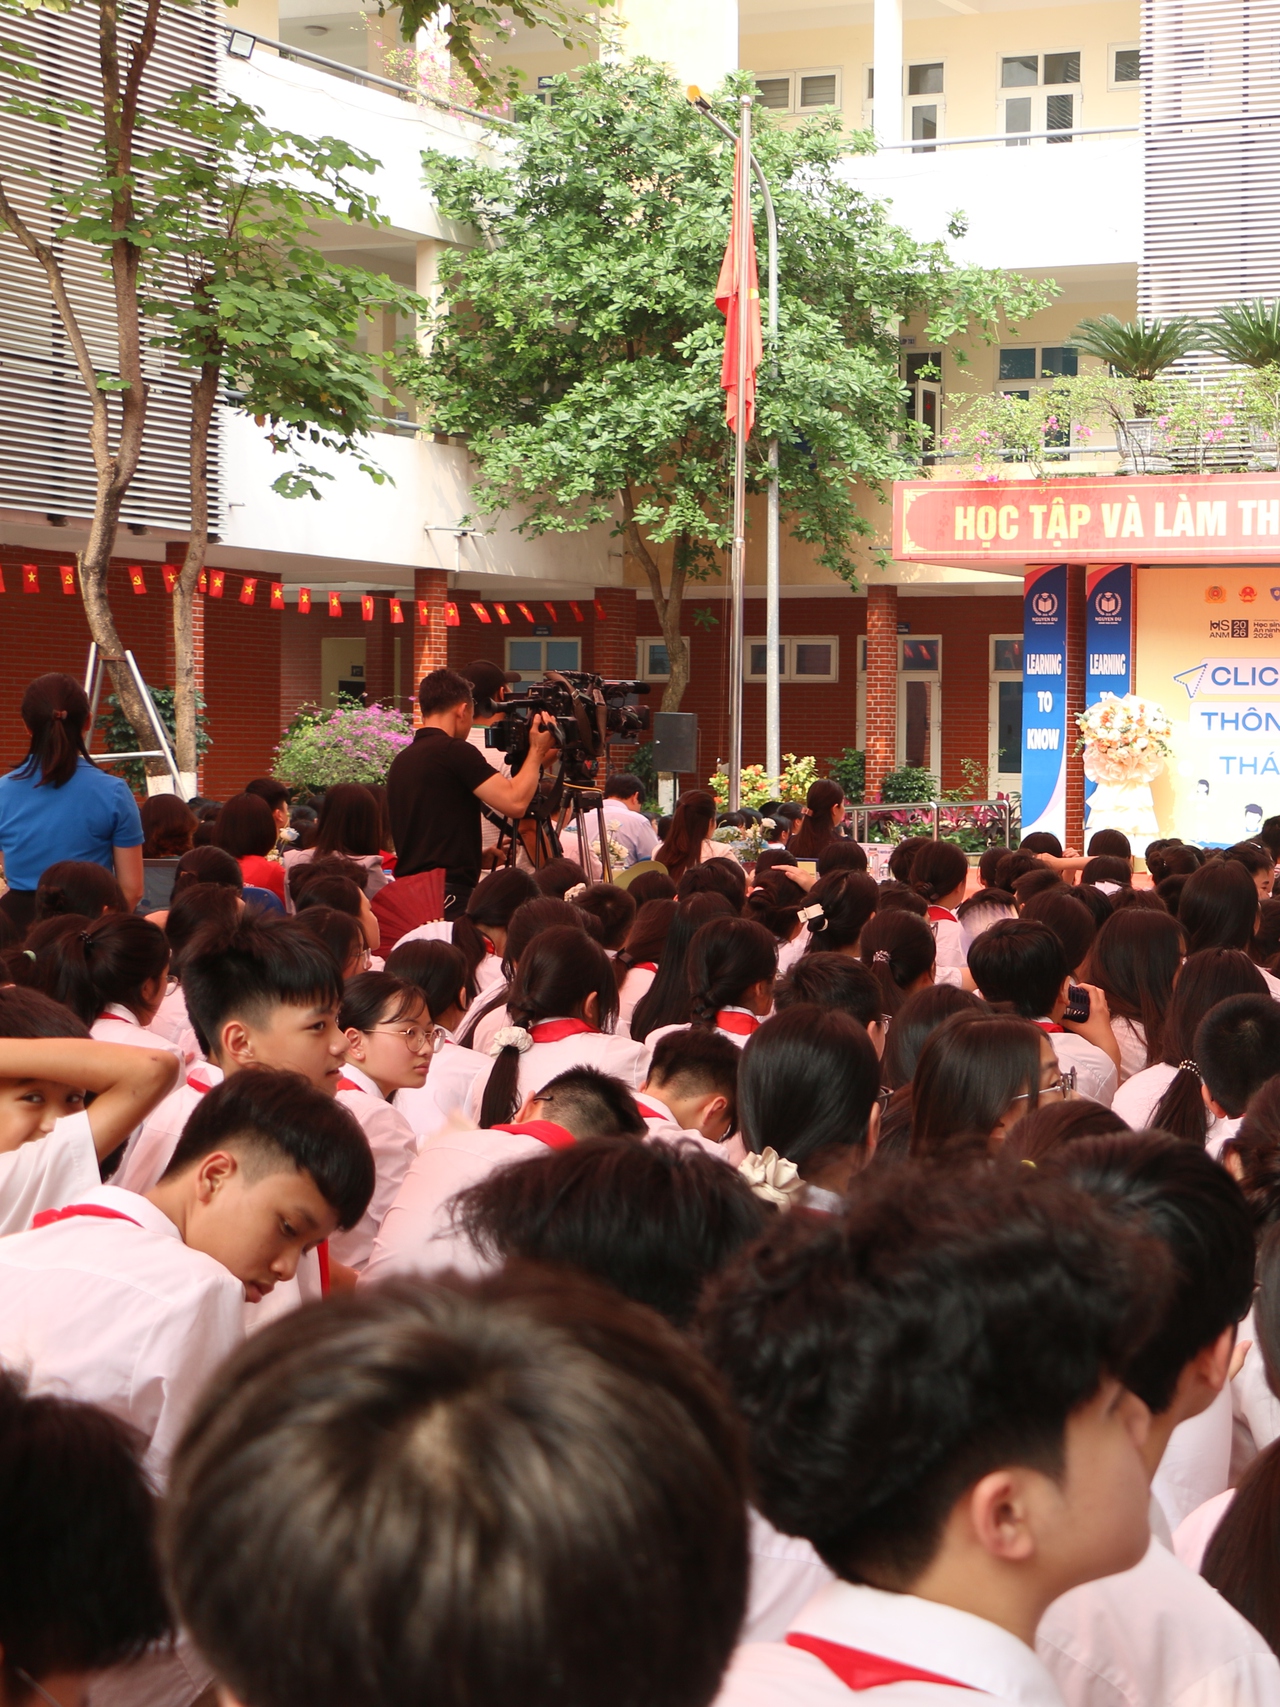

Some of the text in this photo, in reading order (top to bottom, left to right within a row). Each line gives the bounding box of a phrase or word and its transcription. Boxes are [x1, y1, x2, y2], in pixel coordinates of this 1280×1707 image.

[954, 504, 1019, 548] HỌC
[1029, 496, 1091, 547] TẬP
[1101, 494, 1144, 538] VÀ
[1154, 493, 1227, 537] LÀM
[1026, 653, 1062, 675] LEARNING
[1089, 653, 1126, 675] LEARNING
[1037, 691, 1053, 713] TO
[1026, 728, 1060, 750] KNOW
